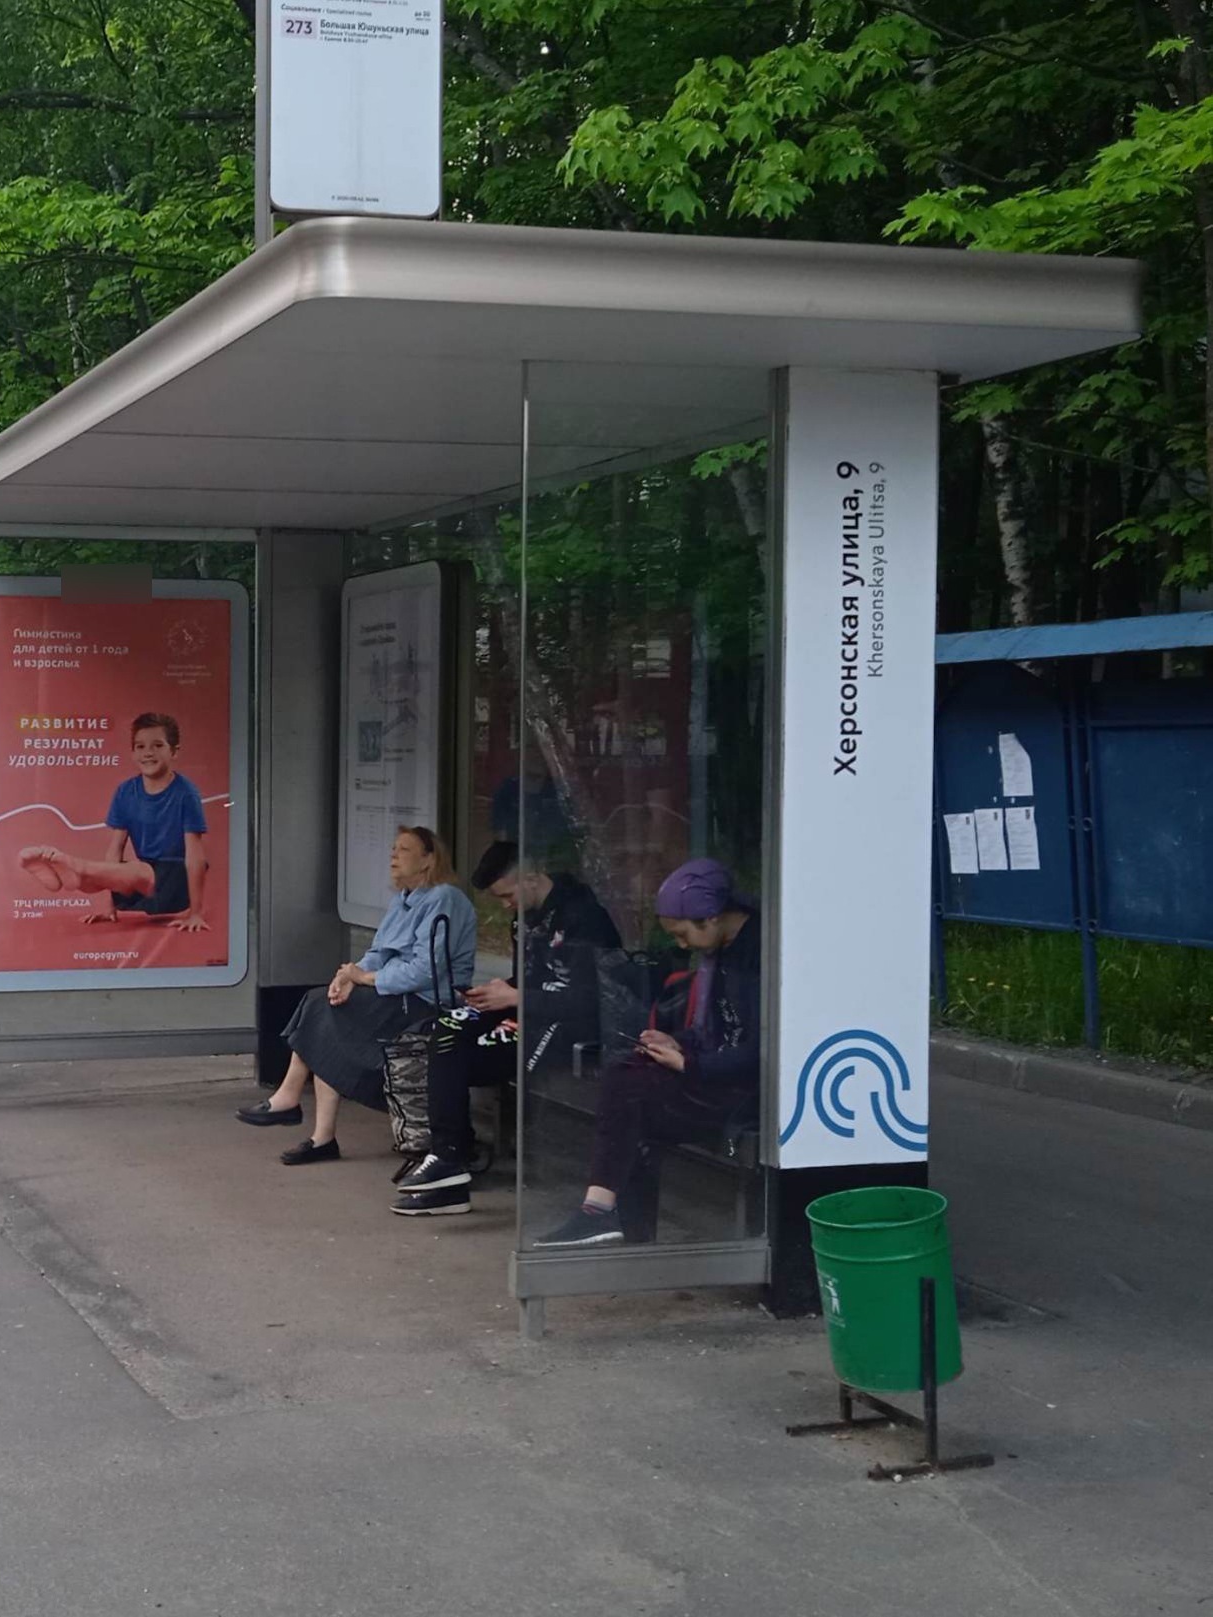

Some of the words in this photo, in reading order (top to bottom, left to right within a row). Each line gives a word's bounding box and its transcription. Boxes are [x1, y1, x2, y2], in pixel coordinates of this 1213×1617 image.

[286, 19, 313, 35] 273
[320, 19, 356, 30] Большая
[405, 27, 429, 36] улица
[837, 461, 860, 480] 9
[868, 462, 885, 474] 9
[868, 478, 887, 539] Ulitsa,
[842, 487, 865, 587] улица,
[867, 545, 888, 678] Khersonskaya
[13, 628, 82, 640] Гимнастика
[13, 645, 36, 655] для
[38, 643, 73, 655] детей
[75, 646, 88, 654] от
[93, 644, 99, 654] 1
[102, 646, 129, 655] года
[13, 659, 22, 668] и
[24, 658, 81, 670] взрослых
[834, 597, 862, 776] Херсонская
[20, 718, 108, 729] РАЗВИТИЕ
[24, 738, 105, 749] РЕЗУЛЬТАТ
[8, 755, 119, 768] УДОВОЛЬСТВИЕ
[13, 899, 32, 908] ТРЦ
[33, 899, 61, 907] PRIME
[63, 898, 91, 907] PLAZA
[13, 910, 20, 919] 3
[22, 911, 44, 919] этаж
[73, 951, 139, 961] europegym.ru
